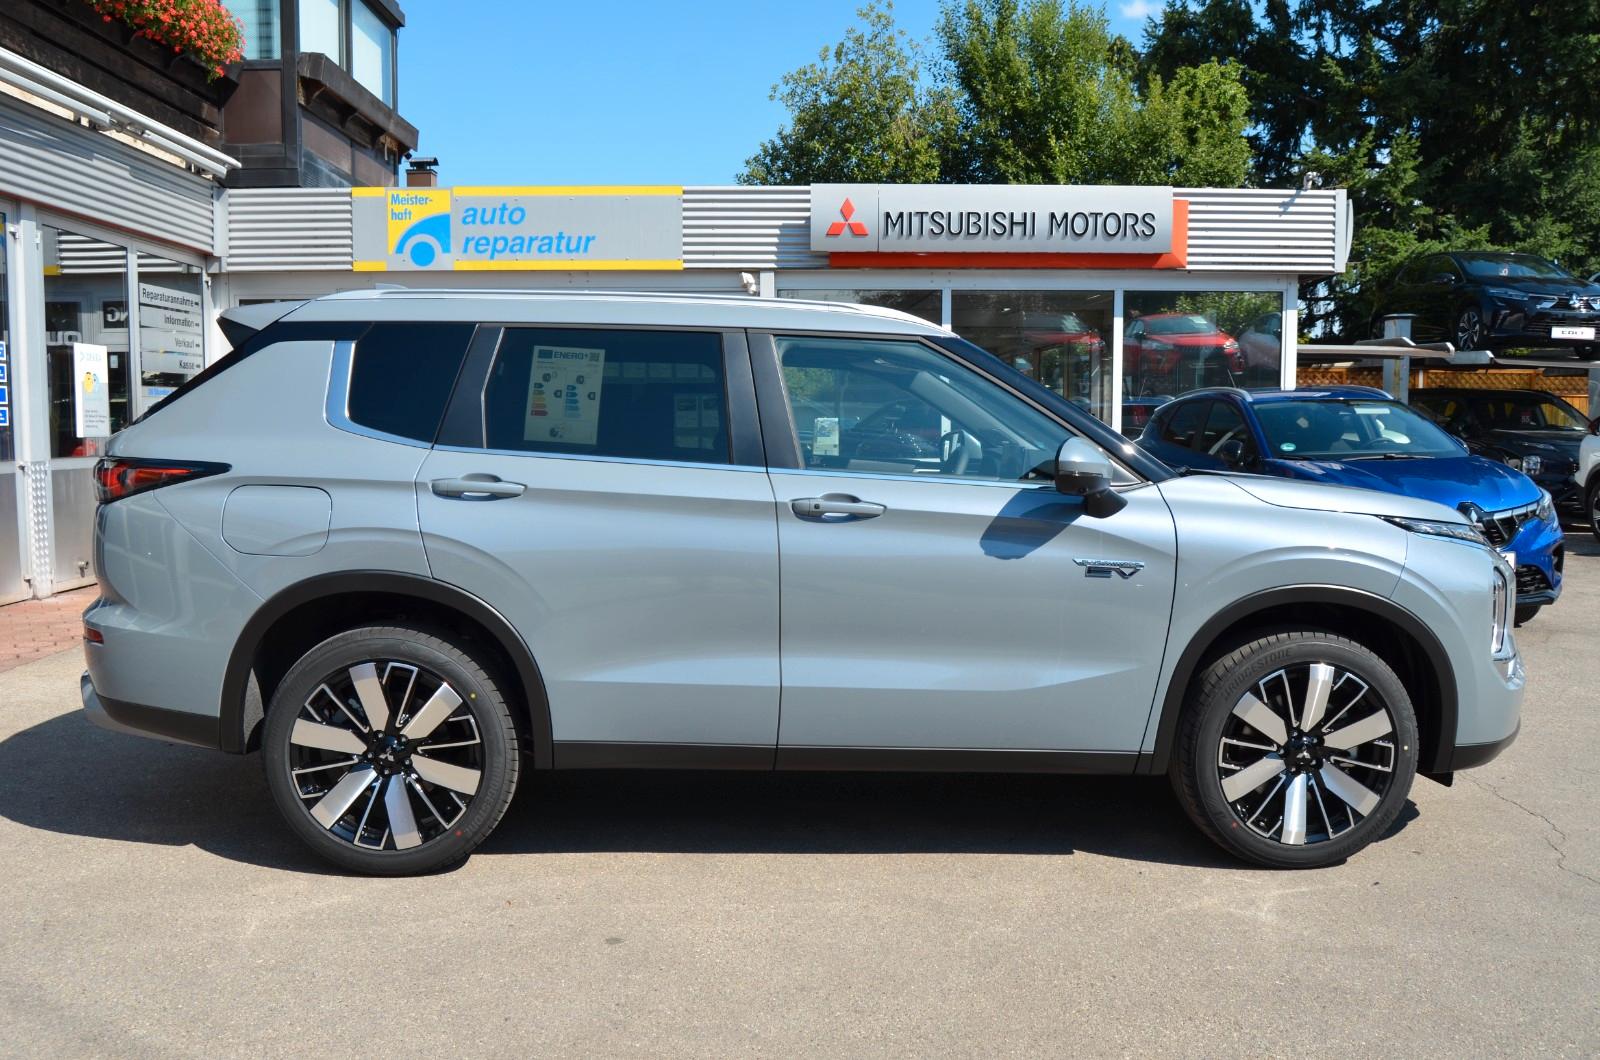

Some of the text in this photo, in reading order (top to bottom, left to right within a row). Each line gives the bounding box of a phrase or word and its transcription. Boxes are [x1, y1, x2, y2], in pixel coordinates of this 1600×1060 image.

[391, 208, 412, 221] haft
[462, 203, 526, 225] auto
[886, 211, 1156, 237] MITSUBISHI MOTORS
[462, 231, 596, 260] reparatur
[142, 287, 194, 307] Reparaturannahme
[164, 314, 195, 328] Information
[174, 337, 195, 349] Verkauf
[178, 360, 195, 370] Kasse
